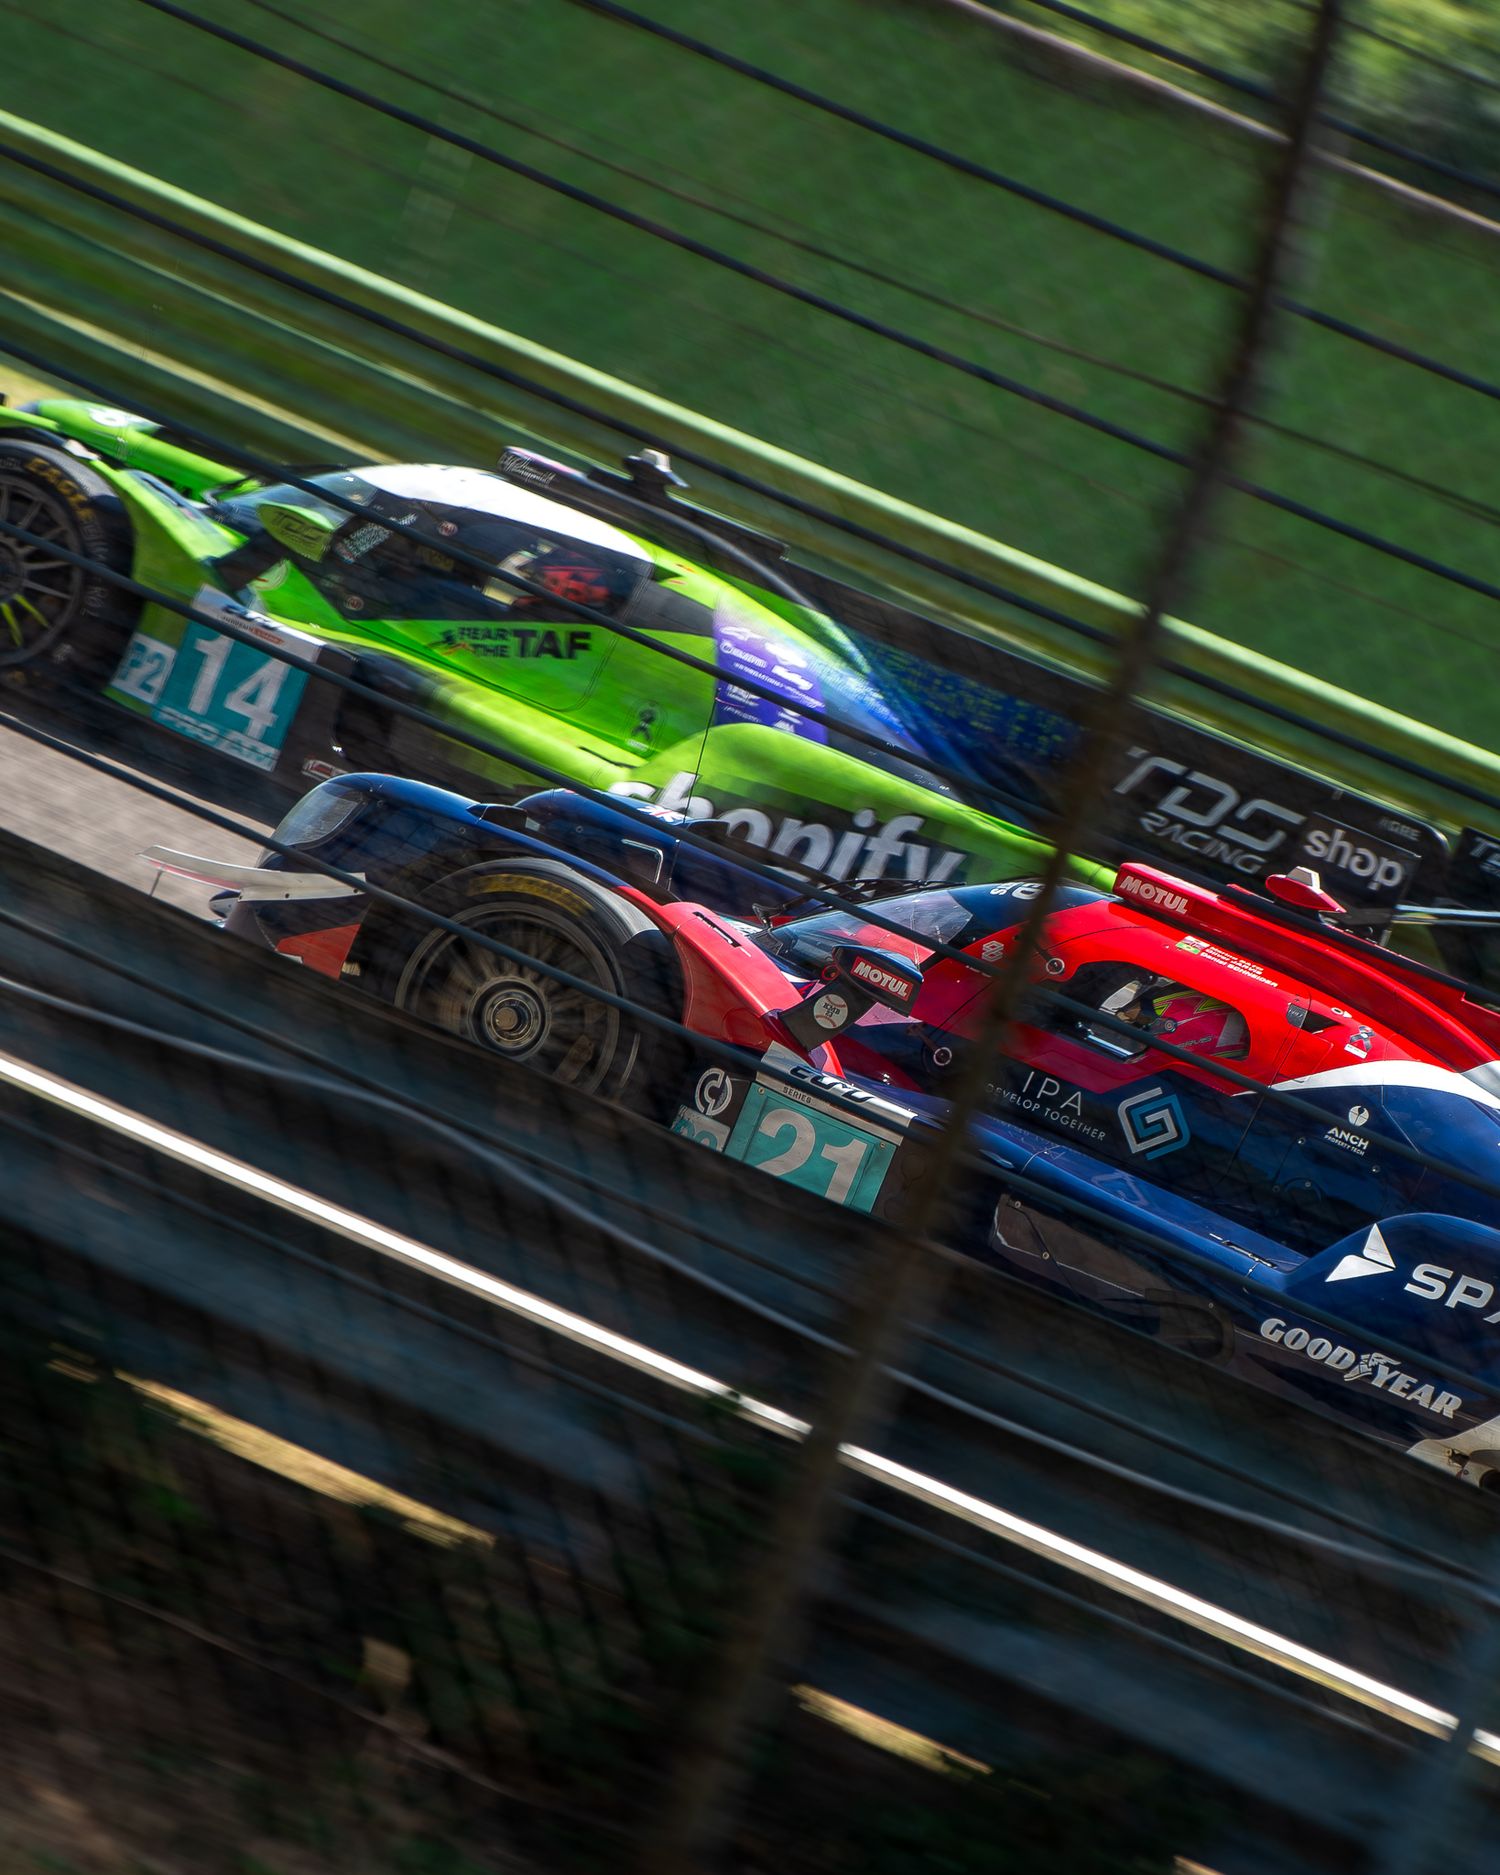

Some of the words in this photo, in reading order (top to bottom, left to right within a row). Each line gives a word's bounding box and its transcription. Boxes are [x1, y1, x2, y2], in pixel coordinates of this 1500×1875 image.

[513, 628, 592, 660] TAF
[117, 640, 168, 694] P2
[188, 634, 292, 740] 14
[1113, 746, 1307, 852] TDS
[1140, 811, 1268, 875] RACING
[1303, 828, 1404, 891] shop
[1119, 875, 1189, 915] MOTUL
[853, 961, 909, 998] MOTUL
[1200, 952, 1228, 966] Daniel
[1226, 963, 1279, 988] SCHNEIDER
[783, 1086, 812, 1104] SERIES
[1022, 1071, 1082, 1116] IPA
[1044, 1107, 1107, 1141] TOGETHER
[1327, 1127, 1369, 1150] ANCH
[758, 1107, 868, 1205] 21
[1260, 1318, 1462, 1420] GOODYEAR
